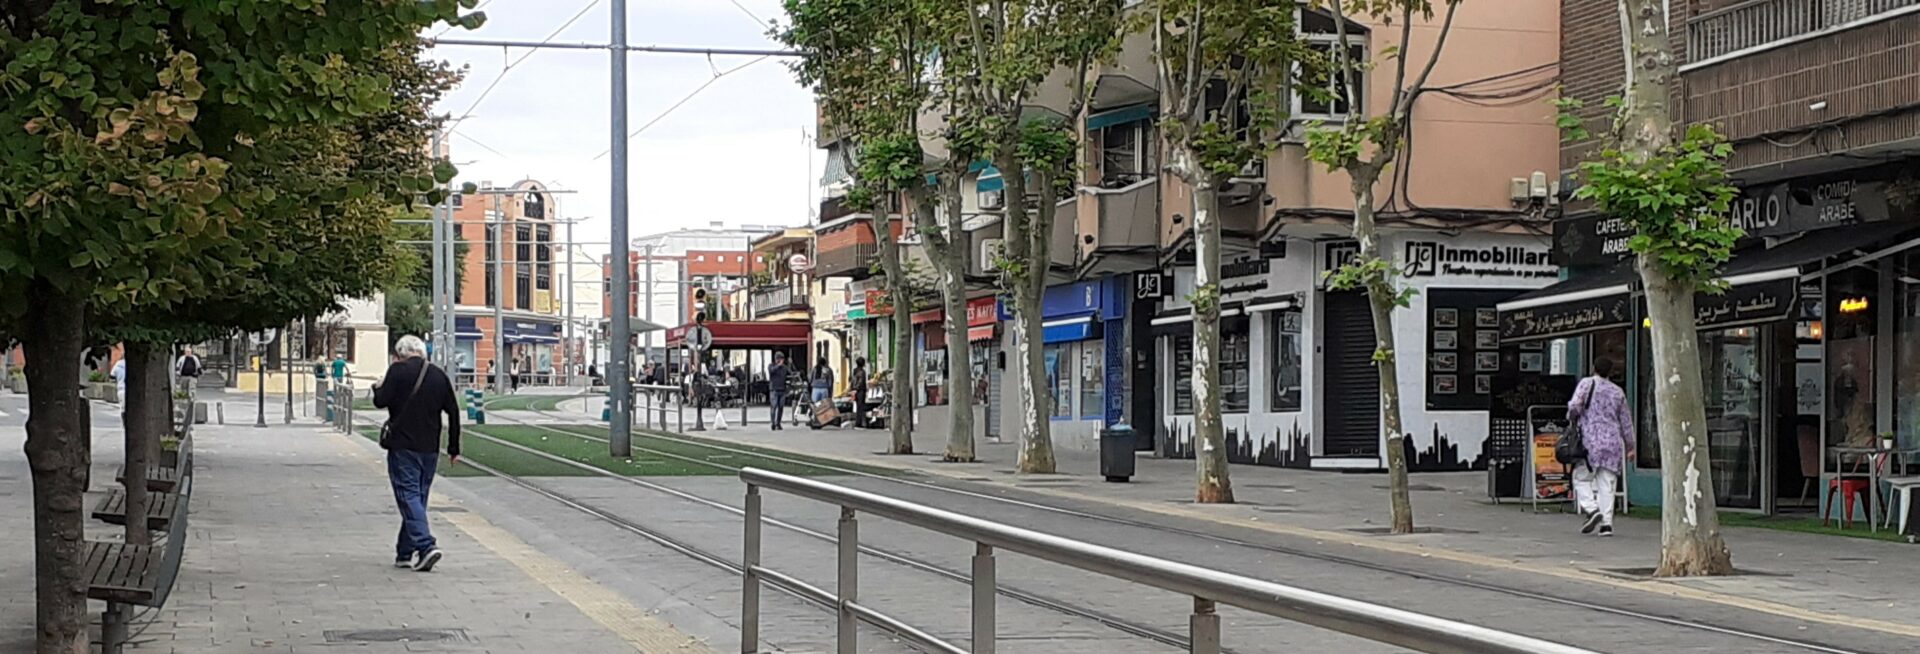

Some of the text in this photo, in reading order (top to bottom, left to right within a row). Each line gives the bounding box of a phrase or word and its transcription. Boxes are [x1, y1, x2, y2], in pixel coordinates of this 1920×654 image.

[1817, 179, 1857, 201] COMIDA
[1730, 194, 1780, 230] ARLO
[1595, 217, 1630, 235] CAFETE
[1438, 244, 1556, 266] Inmobiliari
